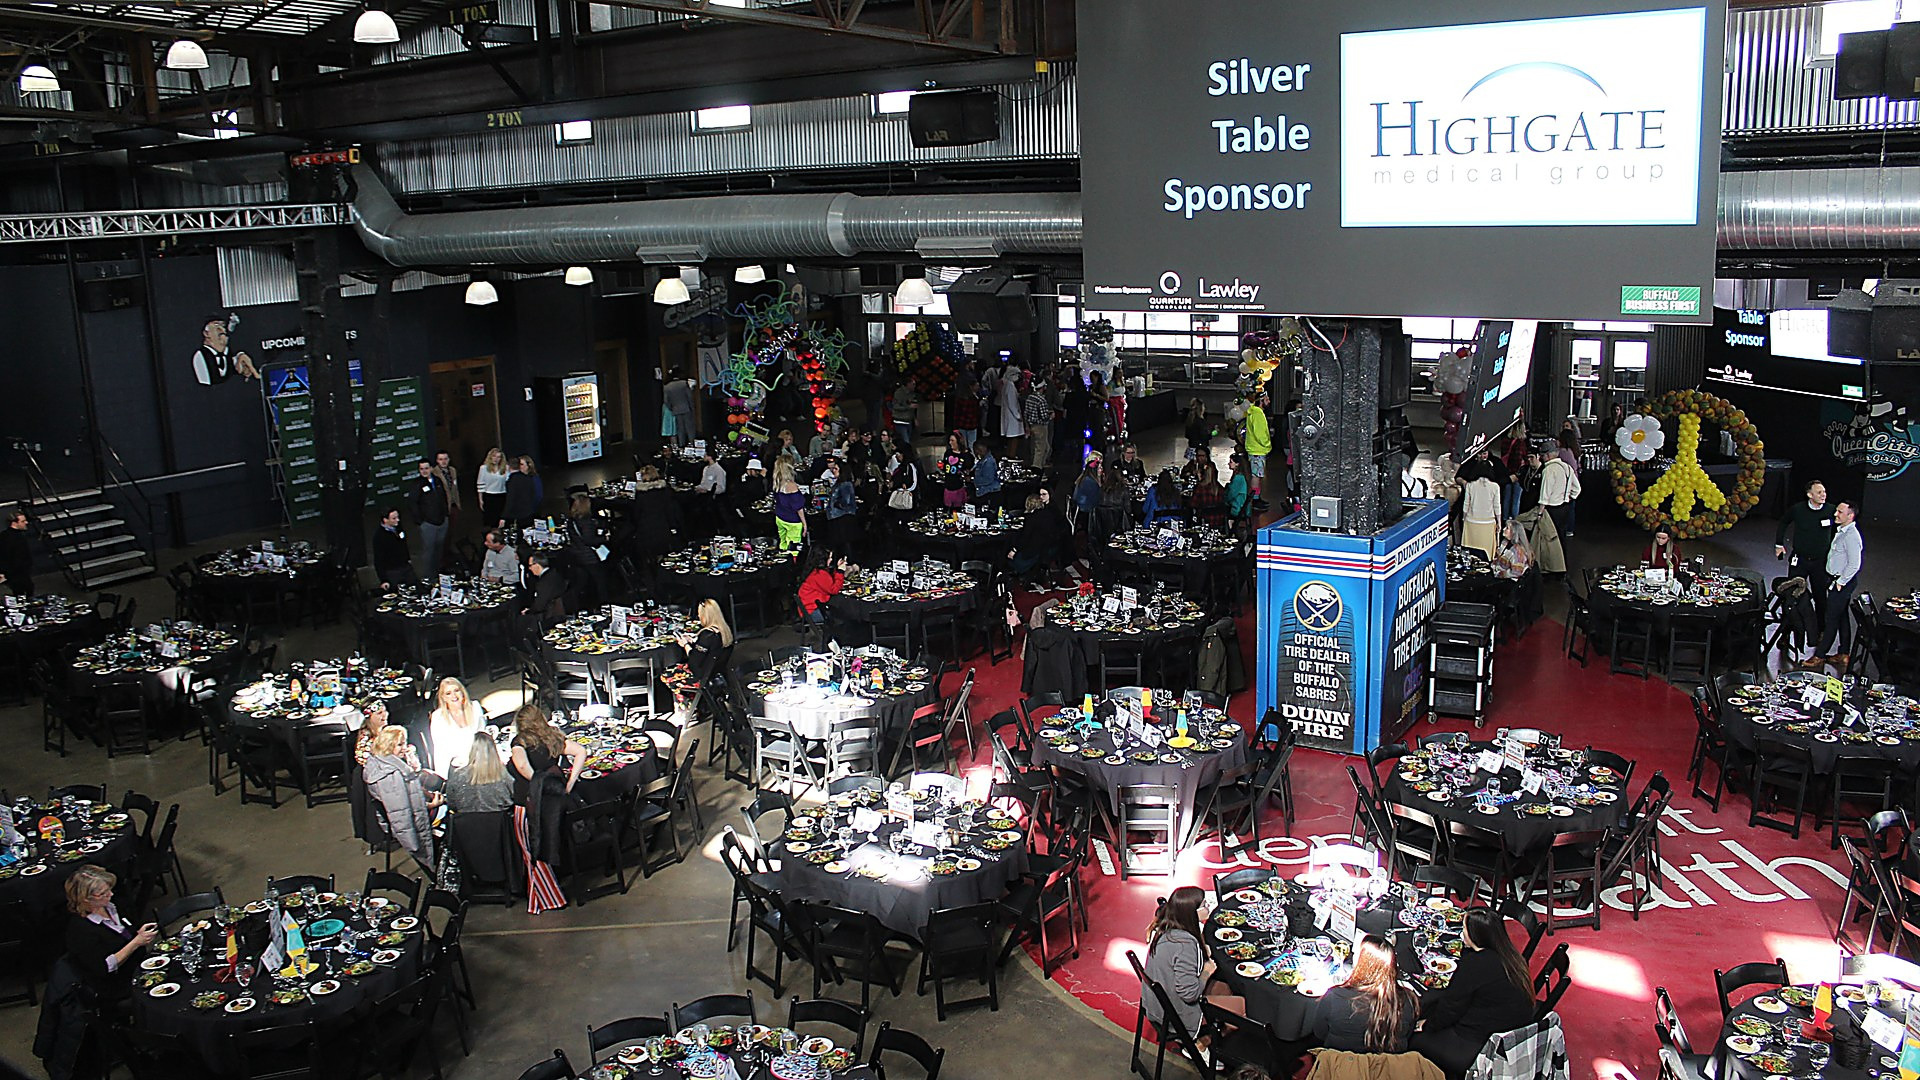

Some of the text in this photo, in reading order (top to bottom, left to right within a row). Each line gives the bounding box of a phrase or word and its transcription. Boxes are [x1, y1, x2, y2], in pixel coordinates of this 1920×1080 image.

[462, 5, 488, 22] TON
[1207, 57, 1311, 96] Silver
[487, 111, 523, 127] 2 TON
[1211, 114, 1310, 154] Table
[1369, 100, 1666, 158] HIGHGATE
[1373, 162, 1665, 185] medical group
[1163, 177, 1312, 220] Sponsor
[1199, 278, 1260, 303] Lawley
[1643, 289, 1680, 300] BUFFALO
[1149, 297, 1192, 305] QUANTUM
[1625, 299, 1696, 311] BUSINESS FIRST
[1736, 309, 1765, 326] Table
[1725, 329, 1765, 347] Sponsor
[1832, 433, 1919, 459] Queen City
[1397, 526, 1439, 566] DUNN TIRE
[1398, 561, 1436, 611] BUFFALO'S
[1394, 587, 1437, 642] HOMETOWN
[868, 643, 878, 652] 29
[1294, 632, 1341, 650] OFFICIAL
[1284, 645, 1350, 664] TIRE DEALER
[1393, 636, 1411, 671] TIRE
[1298, 660, 1336, 675] OF THE
[1293, 672, 1340, 690] BUFFALO
[1164, 689, 1173, 699] 28
[1295, 685, 1338, 702] SABRES
[1281, 703, 1350, 728] DUNN
[1286, 717, 1345, 741] TIRE
[1539, 734, 1549, 745] 27
[929, 786, 941, 798] 21
[1390, 883, 1402, 898] 22
[760, 1050, 770, 1066] 12
